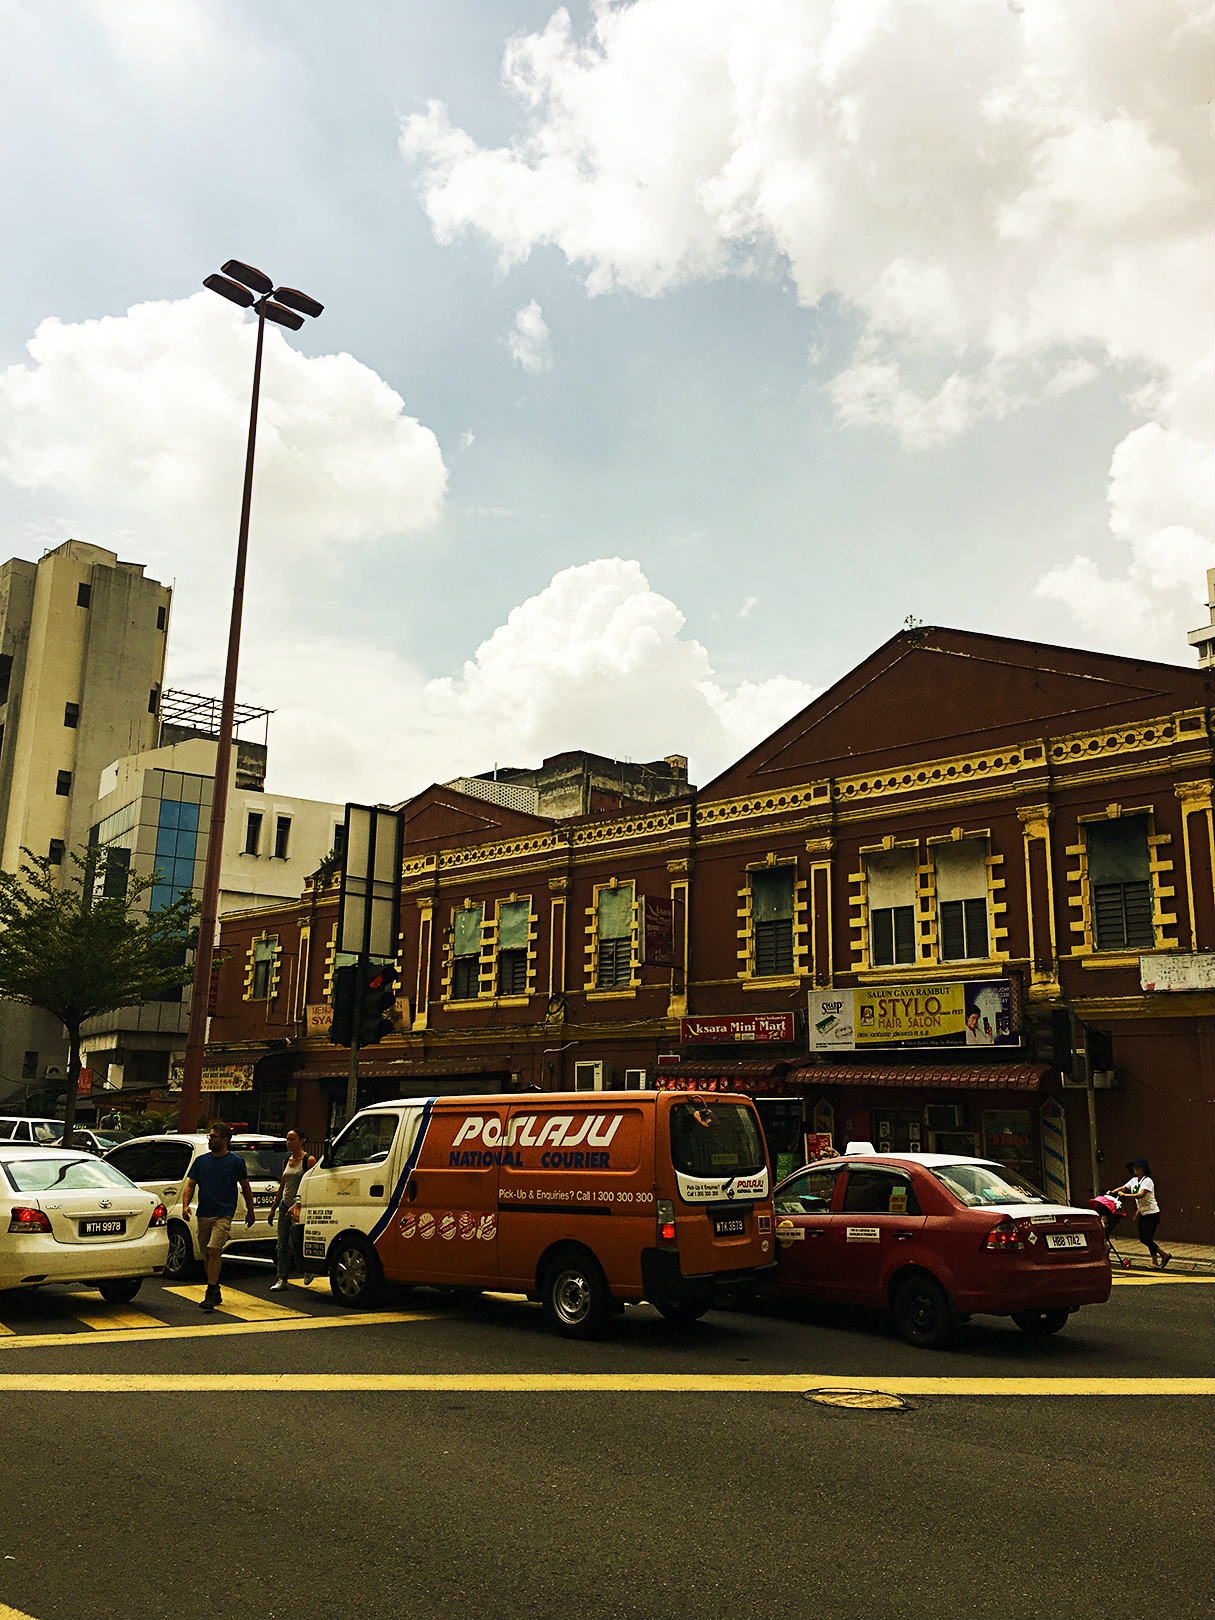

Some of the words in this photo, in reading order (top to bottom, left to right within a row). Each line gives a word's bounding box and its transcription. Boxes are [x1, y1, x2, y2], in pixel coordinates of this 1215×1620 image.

[867, 990, 893, 999] SALUN
[893, 988, 915, 998] GAYA
[915, 987, 951, 997] RAMBUT
[821, 1001, 843, 1015] SHARP
[878, 997, 941, 1018] STYLO
[312, 1016, 332, 1025] SYA
[730, 1021, 756, 1032] Mini
[759, 1020, 786, 1031] Mart
[878, 1017, 902, 1028] HAIR
[908, 1016, 941, 1028] SALON
[449, 1151, 523, 1167] NATIONAL
[541, 1152, 610, 1168] COURIER
[498, 1189, 527, 1199] Pick-Up
[528, 1190, 535, 1199] &
[536, 1190, 574, 1201] Enquiries?
[576, 1190, 591, 1201] Call
[598, 1191, 614, 1202] 300
[616, 1192, 634, 1202] 300
[635, 1192, 654, 1203] 300
[86, 1222, 102, 1233] WTH
[102, 1221, 121, 1232] 9978
